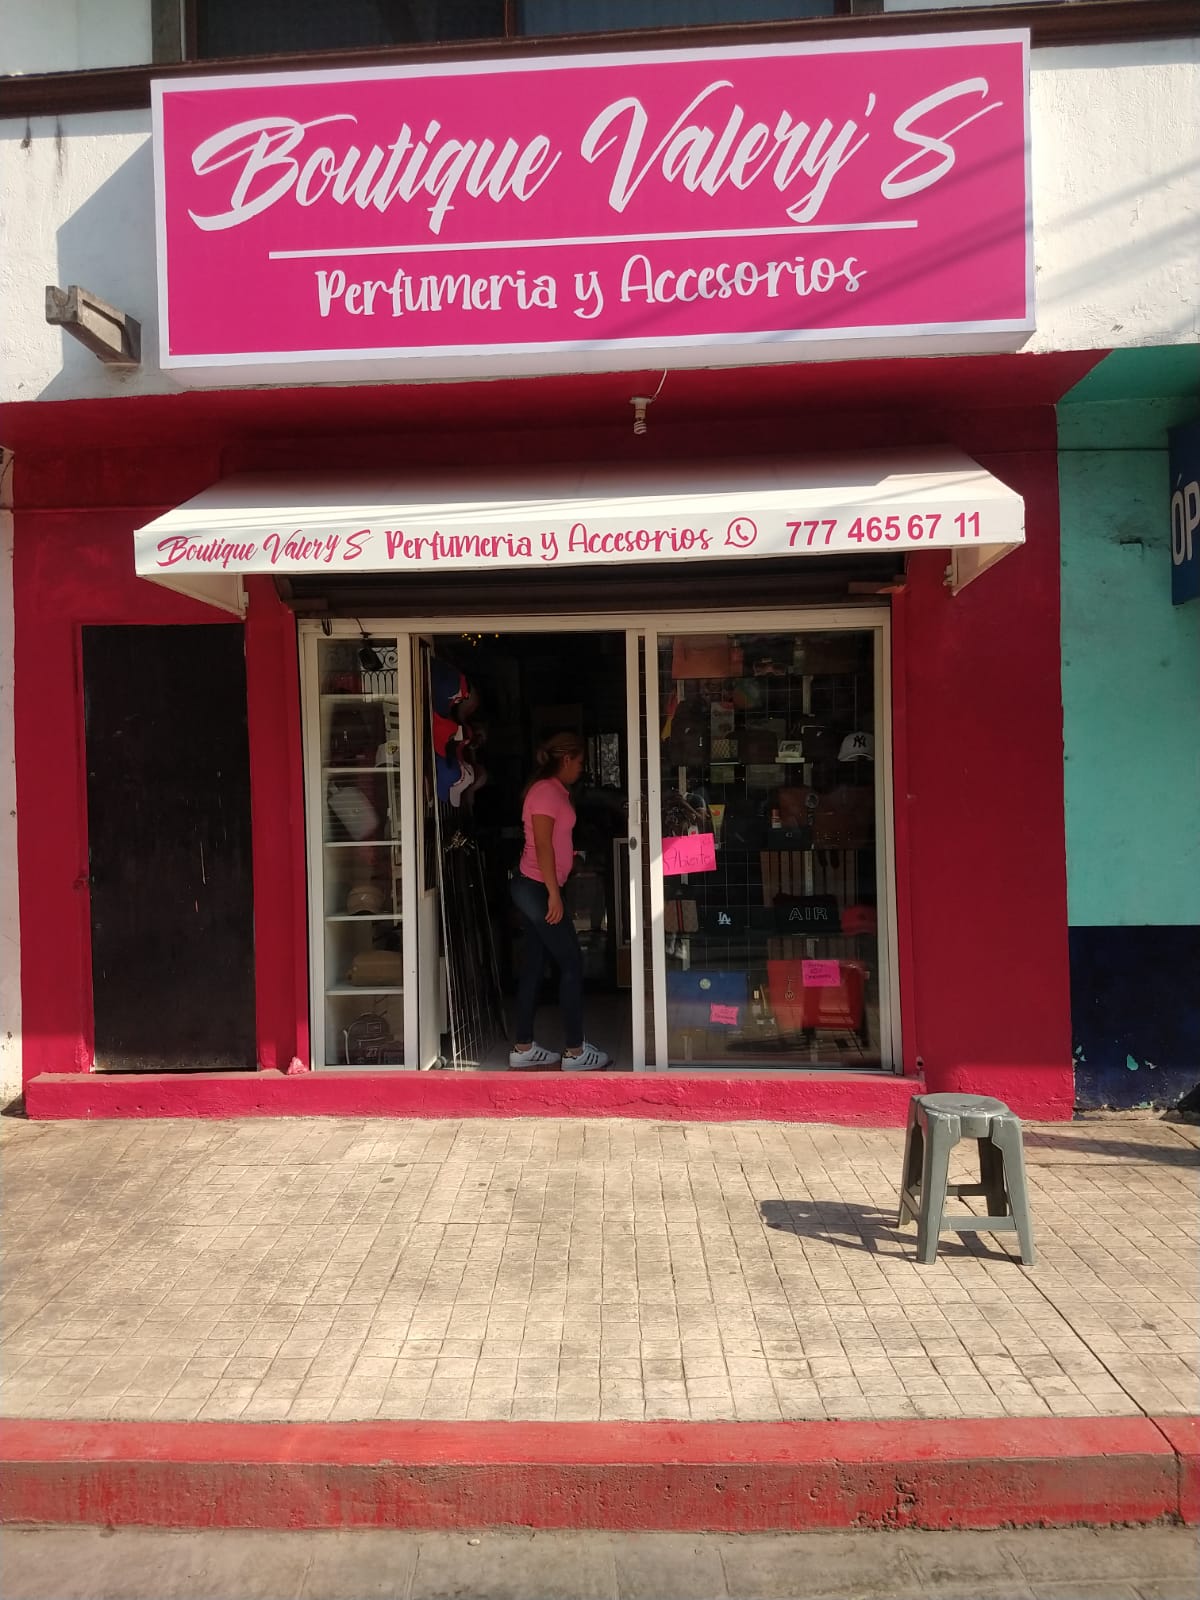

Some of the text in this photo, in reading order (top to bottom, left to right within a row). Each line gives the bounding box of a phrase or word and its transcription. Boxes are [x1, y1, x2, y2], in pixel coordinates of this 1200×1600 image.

[188, 113, 561, 234] Boutique
[315, 254, 866, 319] Perfumeria y Accesorios
[156, 535, 258, 569] Boutique
[385, 530, 532, 560] Perfumeria
[541, 532, 559, 561] y
[568, 523, 713, 554] Accesorios
[786, 519, 839, 547] 777
[953, 511, 980, 539] 11
[718, 911, 732, 925] LA
[788, 906, 828, 921] AIR
